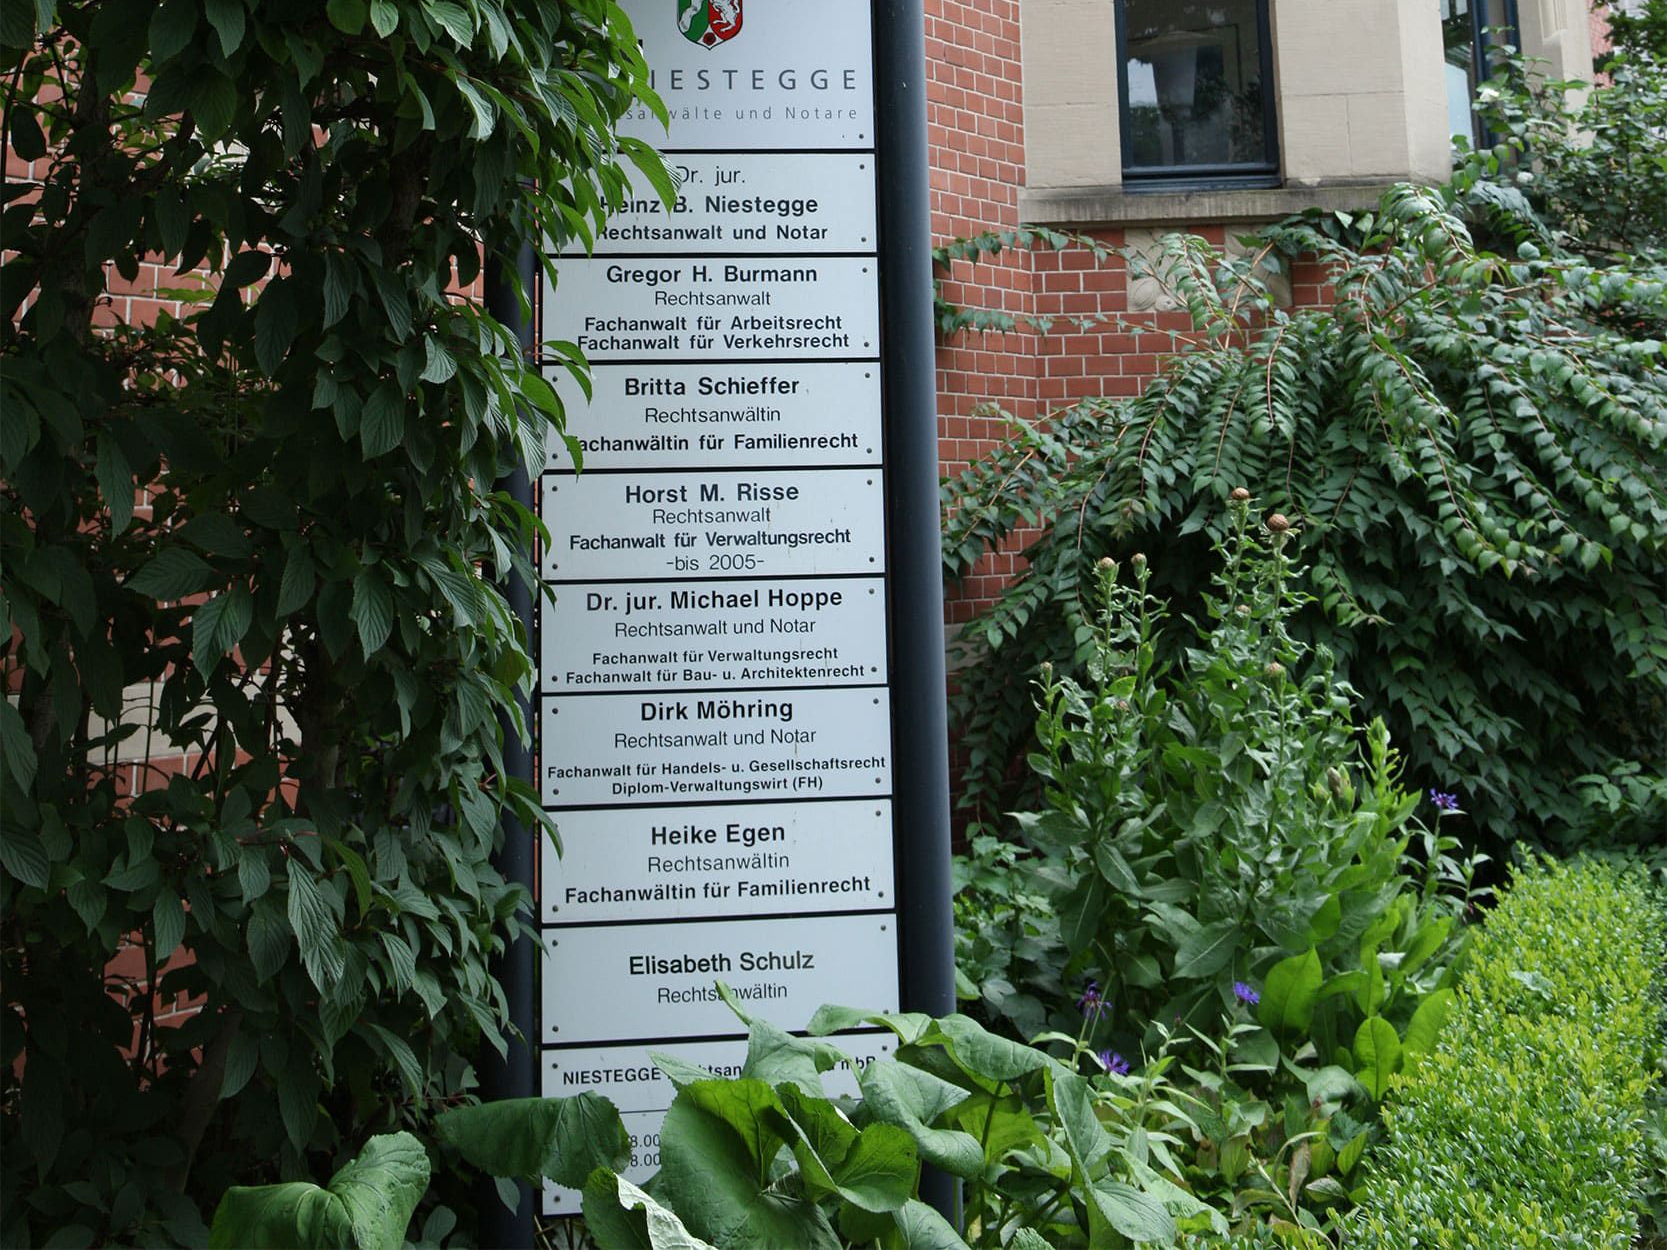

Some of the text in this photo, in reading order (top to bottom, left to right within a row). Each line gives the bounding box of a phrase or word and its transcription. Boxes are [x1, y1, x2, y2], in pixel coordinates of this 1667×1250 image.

[651, 69, 856, 90] IESTEGGE
[626, 107, 857, 119] sawälte und Notare
[676, 166, 744, 186] Dr. jur.
[673, 196, 693, 213] B.
[706, 196, 817, 217] Niestegge
[733, 225, 766, 239] und
[777, 225, 827, 239] Notar
[607, 266, 816, 286] Gregor H. Burmann
[655, 291, 770, 305] Rechtsanwalt
[585, 316, 841, 331] Fachanwalt für Arbeitsrecht
[578, 333, 849, 350] Fachanwalt für Verkehrsrecht
[625, 377, 799, 395] Britta Schieffer
[646, 407, 780, 423] Rechtsanwältin
[566, 433, 858, 452] achanwältin für Familienrecht
[626, 483, 799, 503] Horst M. Risse
[653, 507, 770, 524] Rechtsanwalt
[570, 529, 851, 550] Fachanwalt für Verwaltungsrecht
[667, 554, 764, 571] -bis 2005-
[587, 589, 842, 615] Dr. jur. Michael Hoppe
[616, 619, 815, 637] Rechtsanwalt und Notar
[593, 648, 837, 664] Fachanwalt für Verwaltungsrecht
[567, 665, 864, 684] Fachanwalt für Bau- u. Architektenrecht
[642, 699, 792, 722] Dirk Möhring
[615, 729, 816, 748] Rechtsanwalt und Notar
[548, 757, 885, 778] Fachanwalt für Handels- u. Gesellschaftsrecht
[613, 777, 822, 797] Diplom-Verwaltungswirt (FH)
[652, 824, 784, 847] Heike Egen
[649, 853, 789, 872] Rechtsanwältin
[566, 877, 870, 903] Fachanwältin für Familienrecht
[630, 951, 814, 975] Elisabeth Schulz
[563, 1068, 661, 1085] NIESTEGGE
